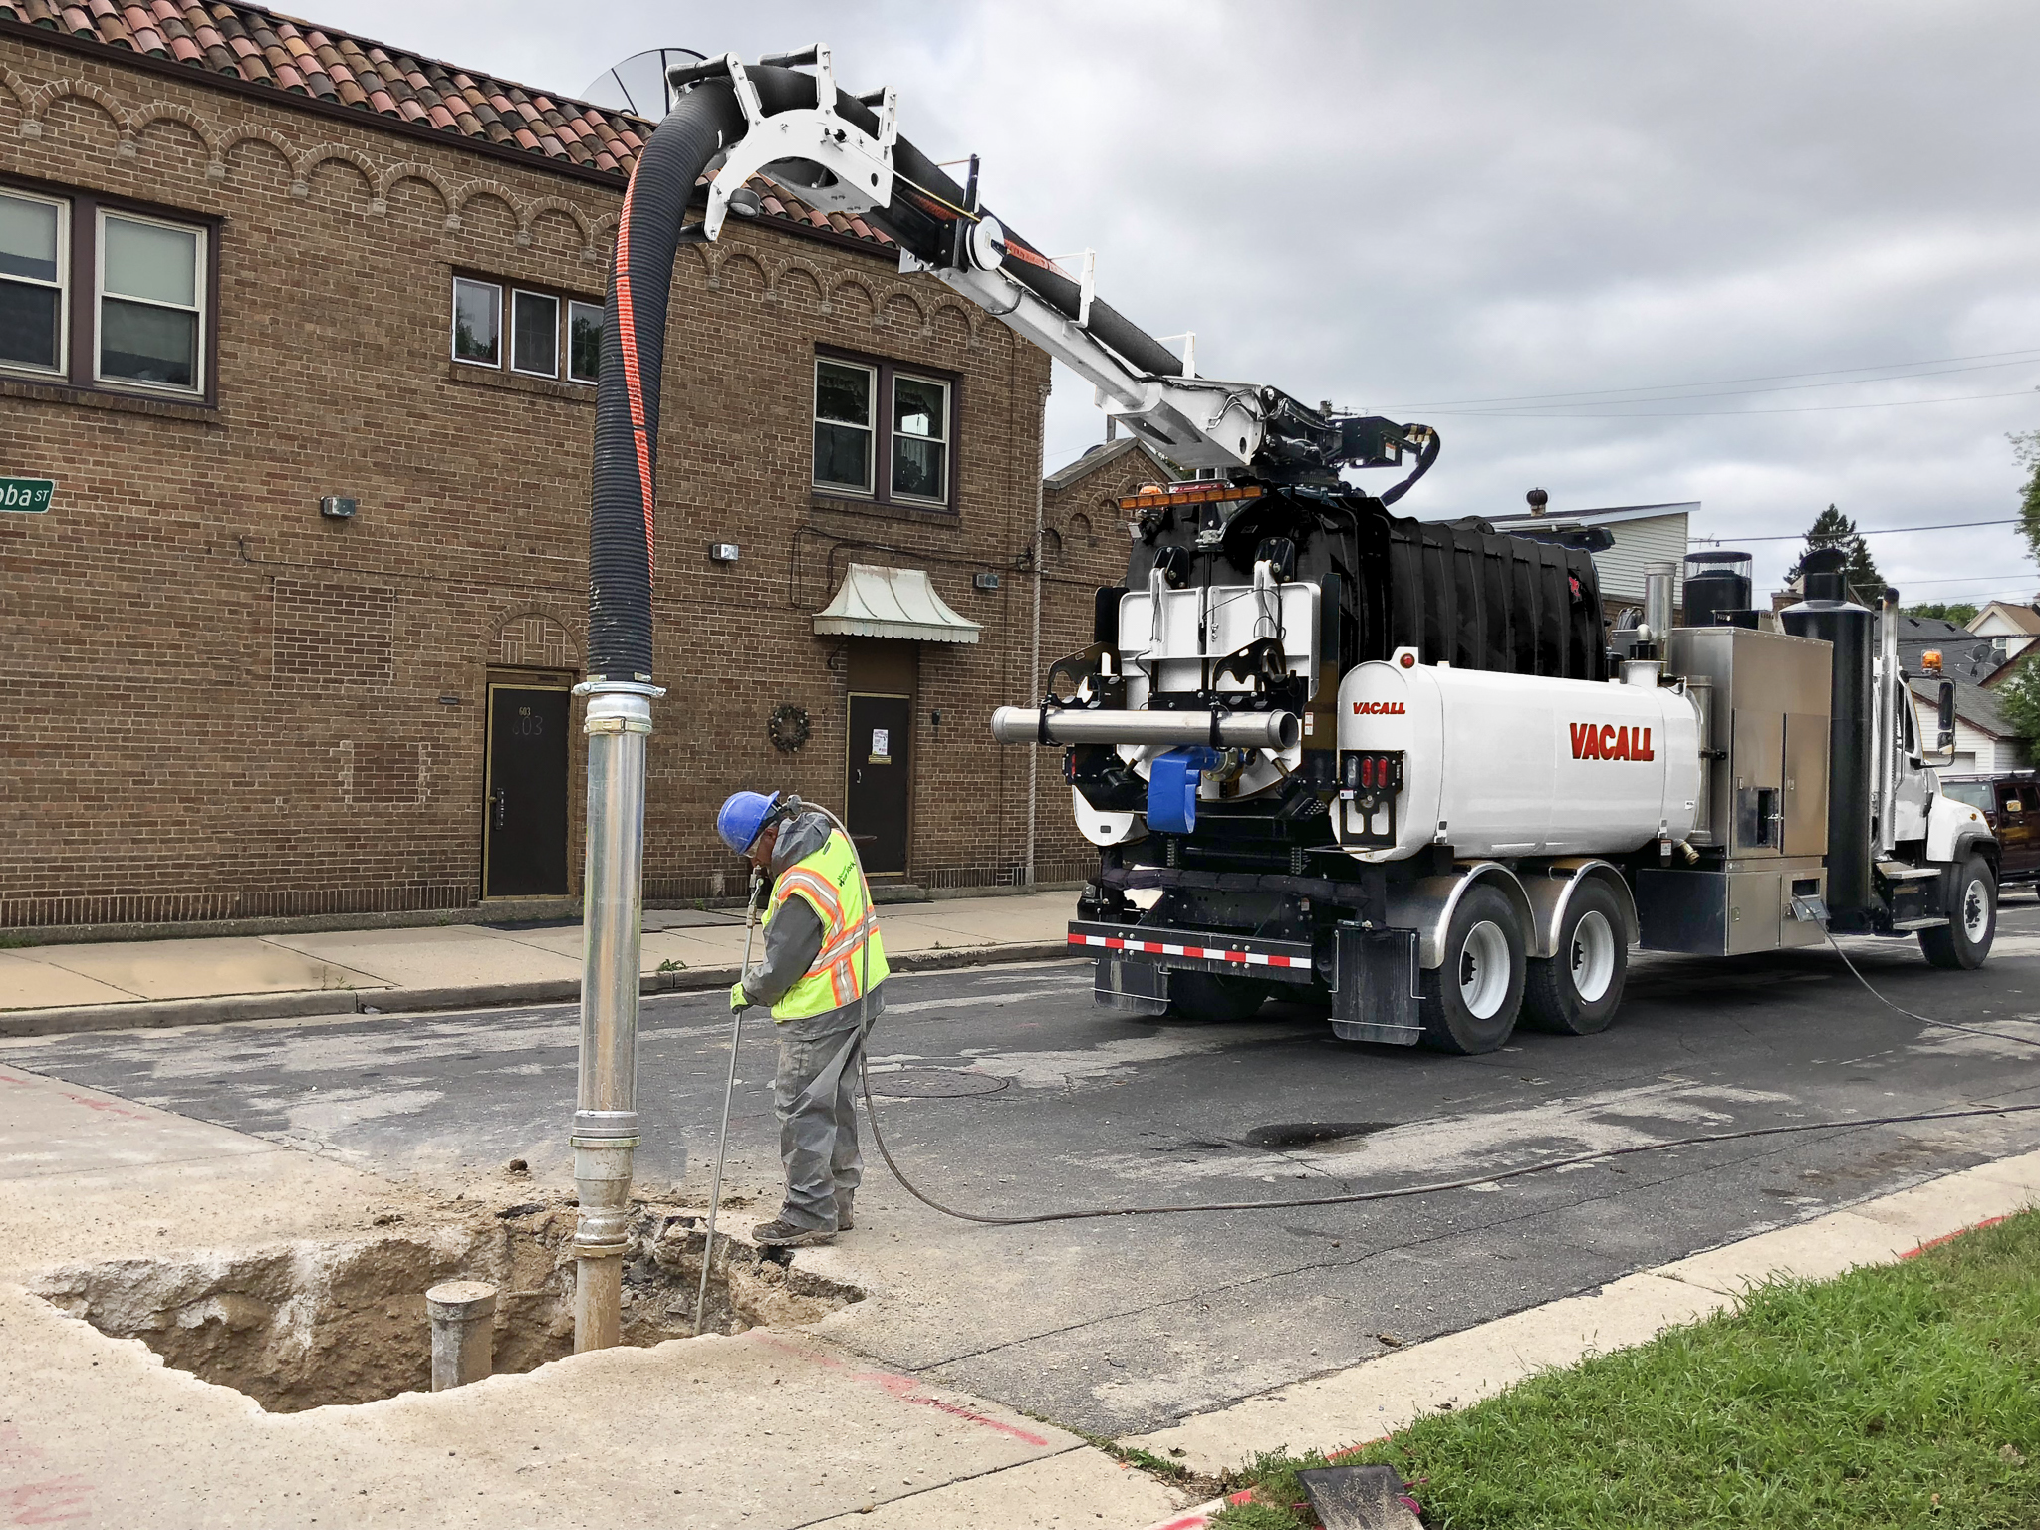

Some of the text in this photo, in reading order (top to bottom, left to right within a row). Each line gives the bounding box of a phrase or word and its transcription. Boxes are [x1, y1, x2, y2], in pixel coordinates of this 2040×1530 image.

[34, 490, 49, 502] ST
[519, 706, 531, 716] 603
[1353, 702, 1406, 714] VACALL
[1569, 723, 1655, 762] VACALL
